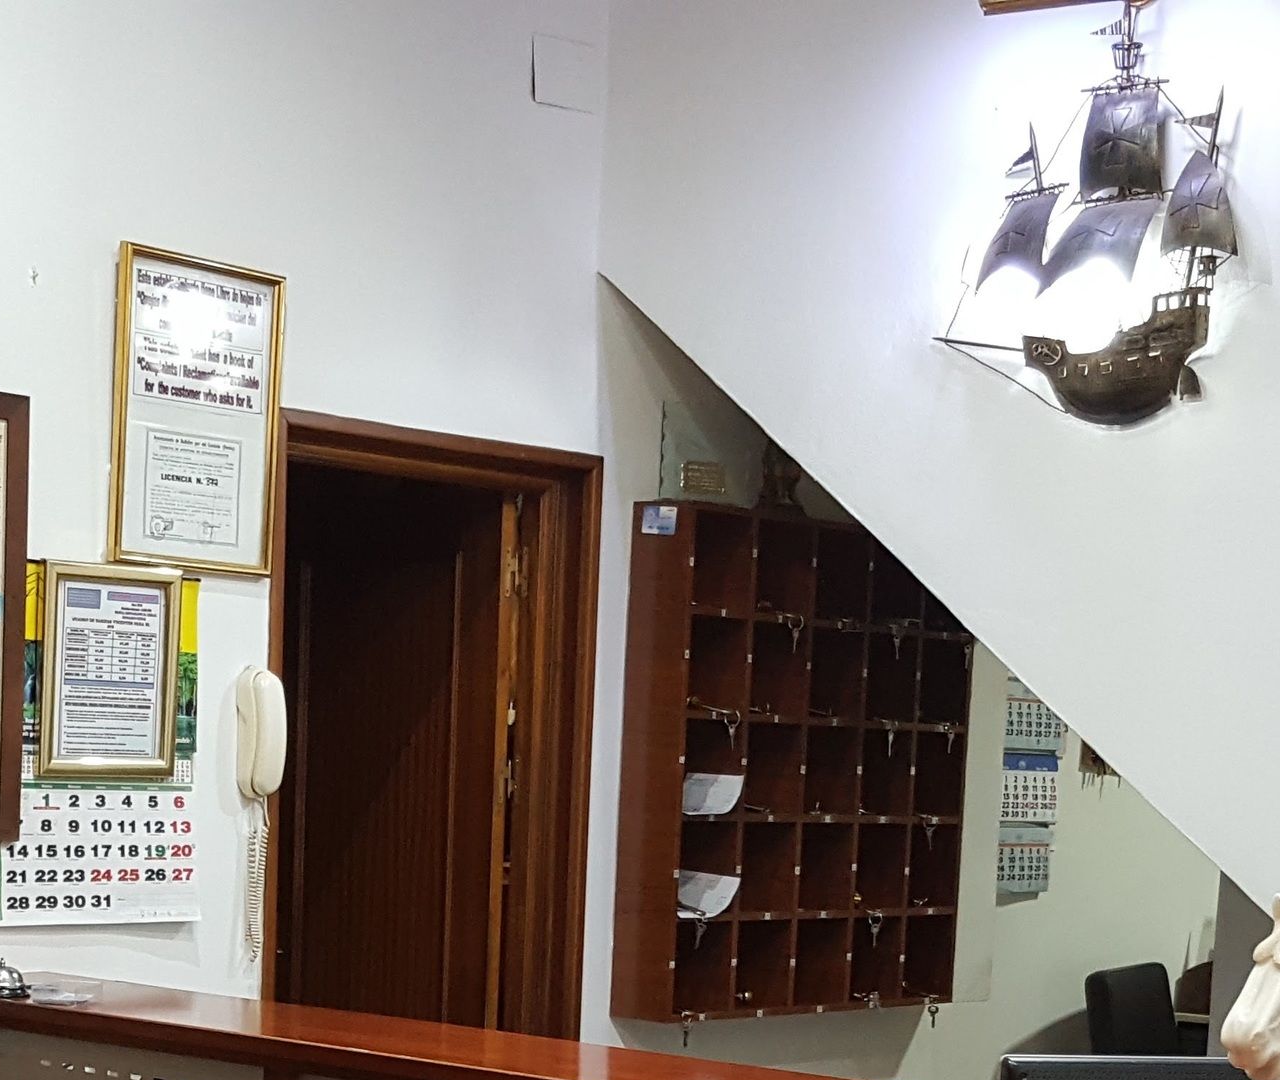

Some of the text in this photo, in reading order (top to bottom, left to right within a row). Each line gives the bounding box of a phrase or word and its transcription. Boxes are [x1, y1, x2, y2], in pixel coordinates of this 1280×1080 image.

[144, 378, 154, 392] for
[158, 381, 169, 395] the
[171, 385, 201, 400] customer
[203, 389, 217, 403] who
[219, 392, 234, 406] asks
[236, 393, 245, 407] for
[160, 473, 192, 483] LICENCIA
[42, 794, 185, 809] 1 2 3 4 5 6
[41, 819, 191, 834] 8 9 10 11 12 13
[6, 845, 192, 858] 14 15 16 17 18 19 20
[6, 868, 193, 884] 21 22 23 24 25 26 27
[7, 895, 112, 910] 28 29 30 31
